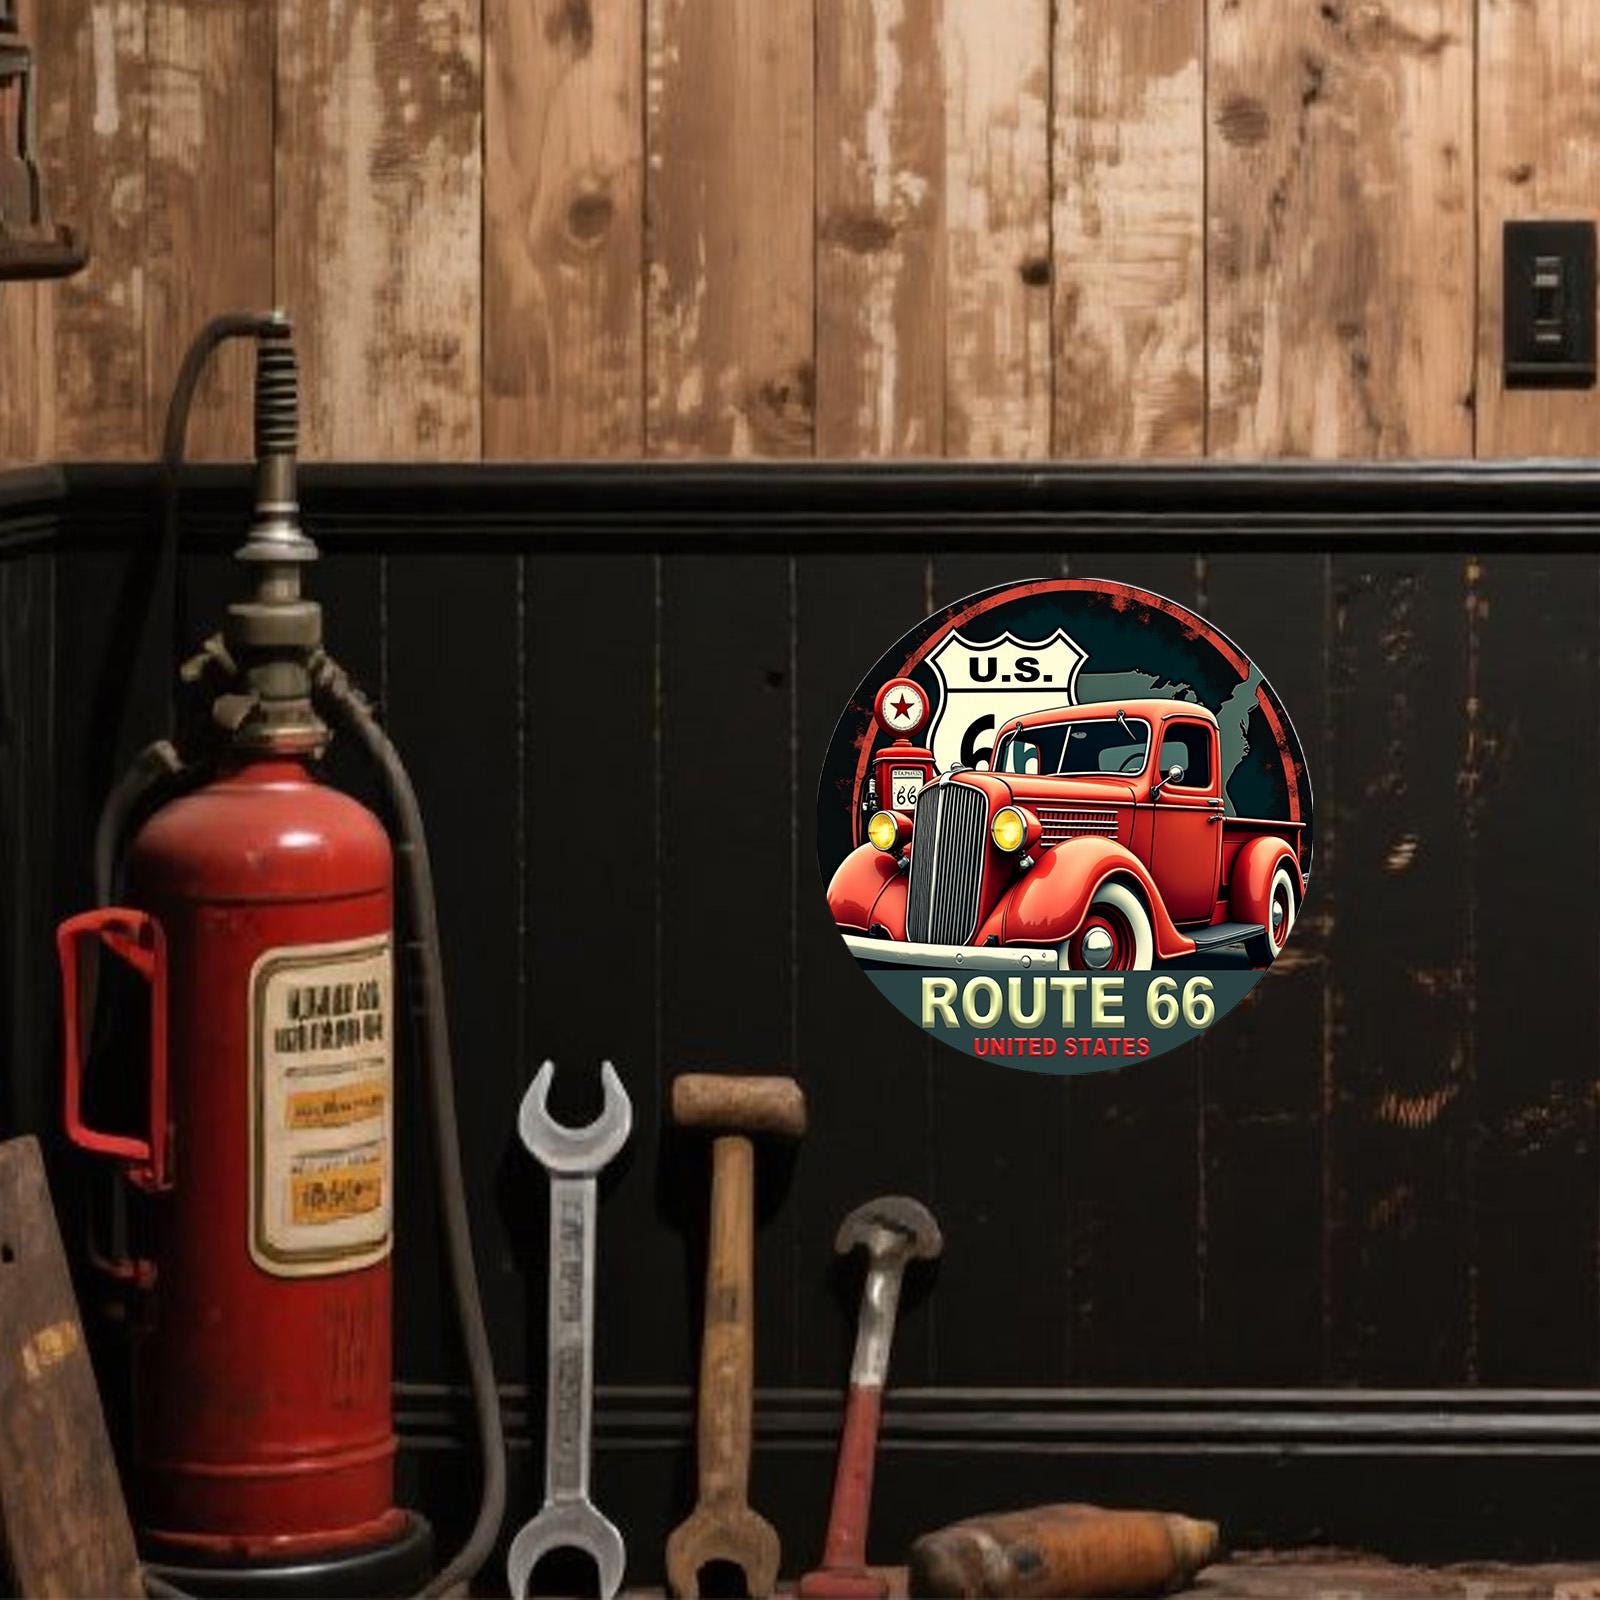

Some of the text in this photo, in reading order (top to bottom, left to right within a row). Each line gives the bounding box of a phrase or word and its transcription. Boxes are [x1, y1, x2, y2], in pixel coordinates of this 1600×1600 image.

[969, 656, 1053, 683] U.S.
[896, 785, 917, 805] 66
[921, 975, 1216, 1030] ROUTE 66
[973, 1037, 1151, 1057] UNITED STATES
